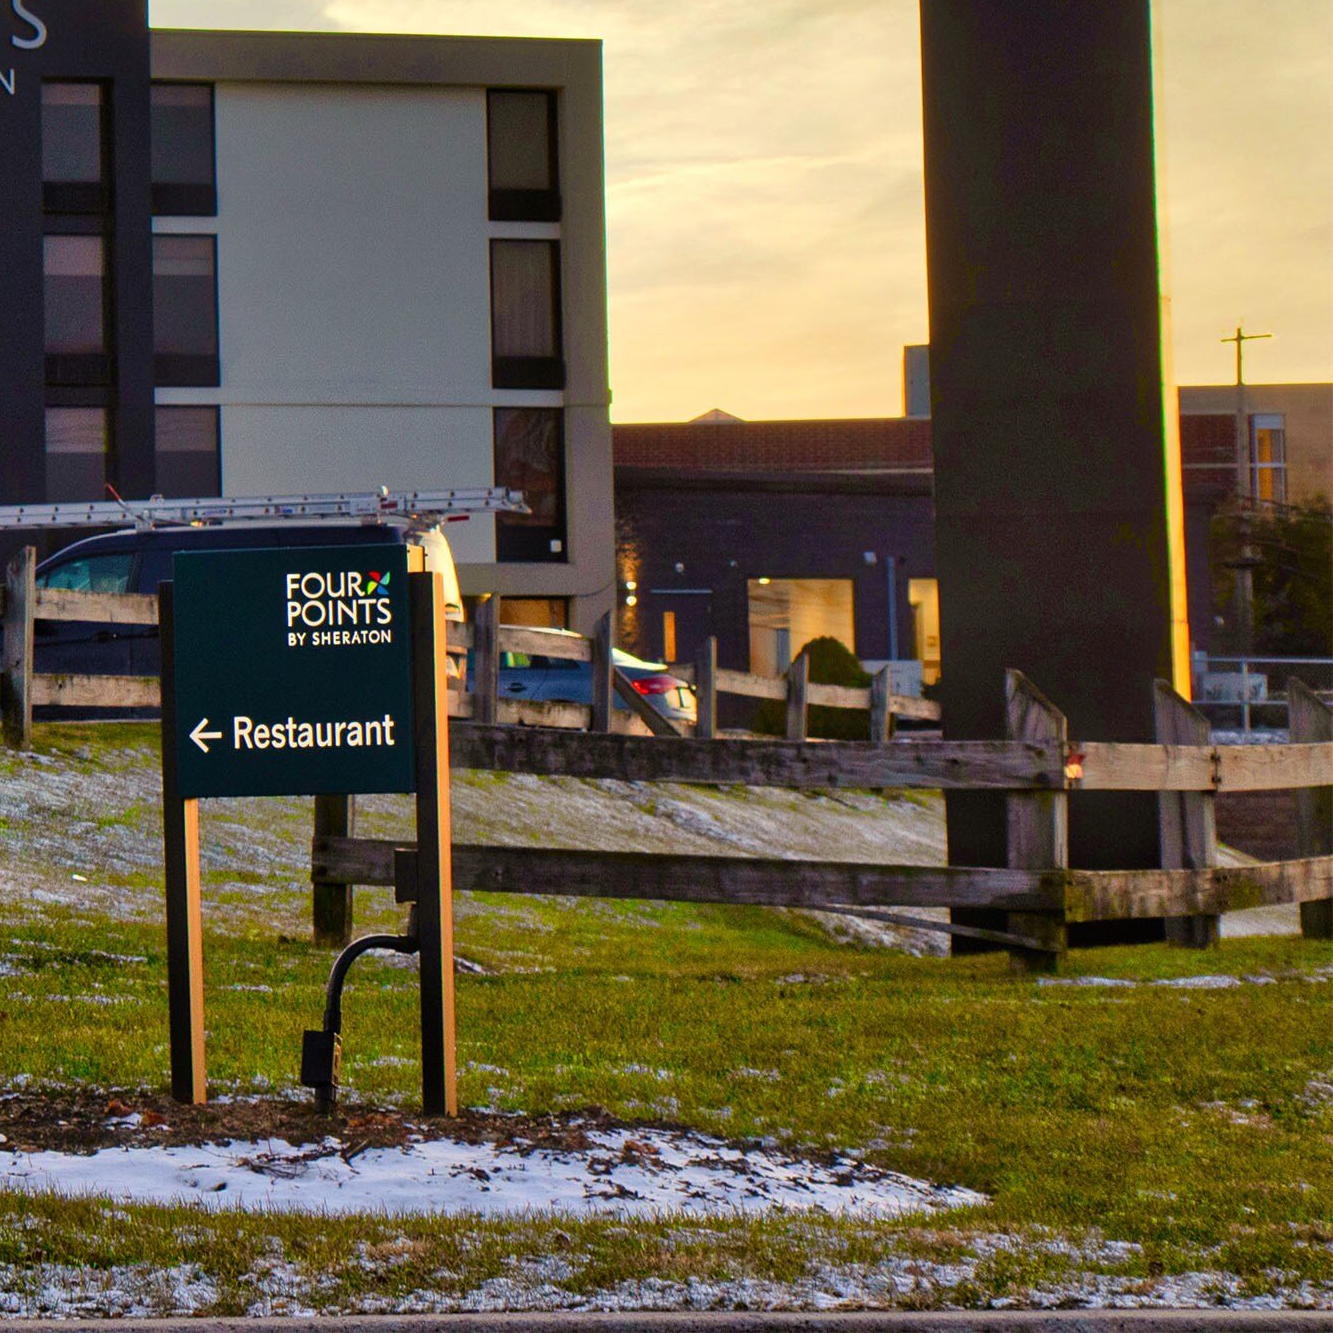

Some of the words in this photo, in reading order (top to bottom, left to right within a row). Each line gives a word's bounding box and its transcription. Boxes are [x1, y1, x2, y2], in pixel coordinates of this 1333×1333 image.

[286, 571, 366, 600] FOUR
[287, 597, 392, 627] POINTS
[287, 632, 307, 647] BY
[311, 629, 392, 646] SHERATON
[233, 713, 395, 750] Restaurant
